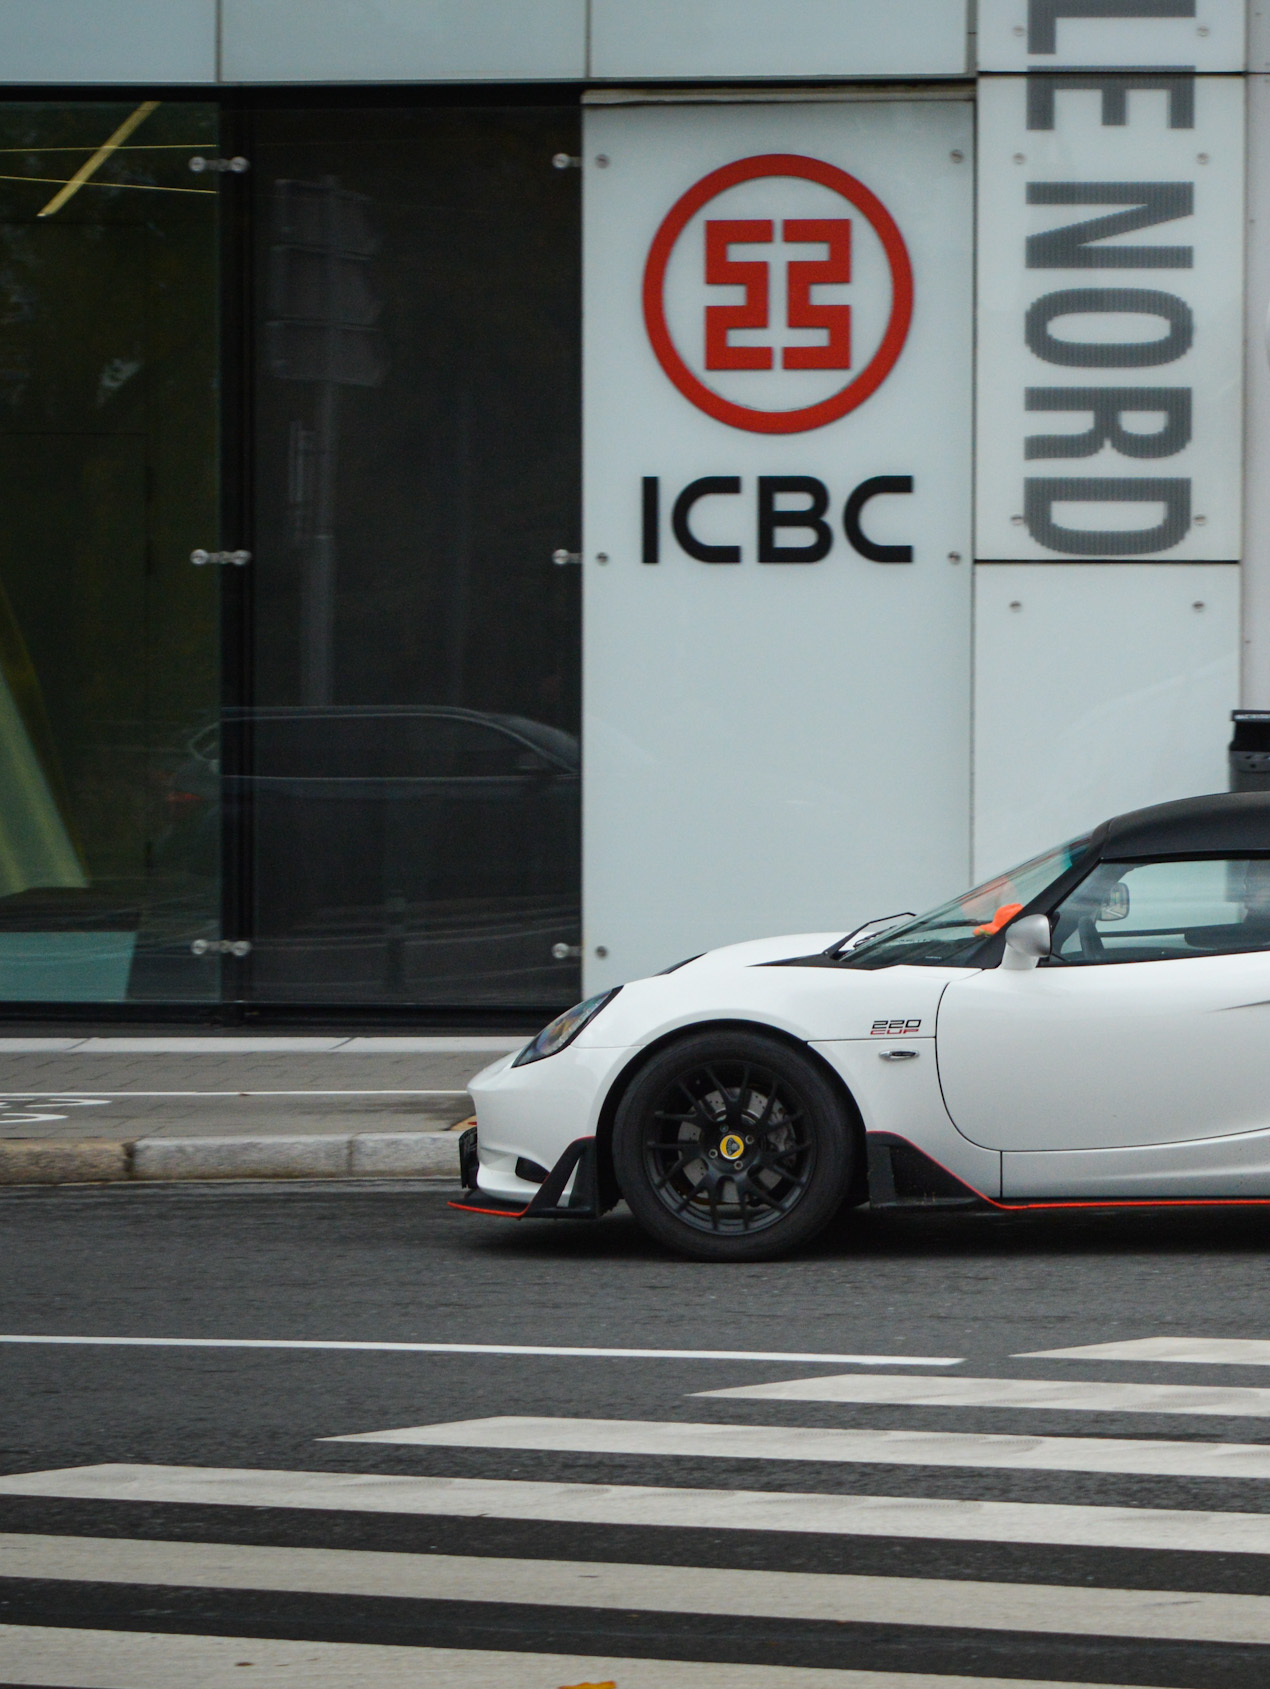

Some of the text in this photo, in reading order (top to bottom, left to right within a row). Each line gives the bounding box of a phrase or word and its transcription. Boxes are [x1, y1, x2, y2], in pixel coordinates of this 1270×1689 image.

[1023, 181, 1195, 556] NORD
[641, 475, 914, 564] ICBC
[870, 1028, 919, 1036] CUP
[871, 1019, 922, 1029] 220
